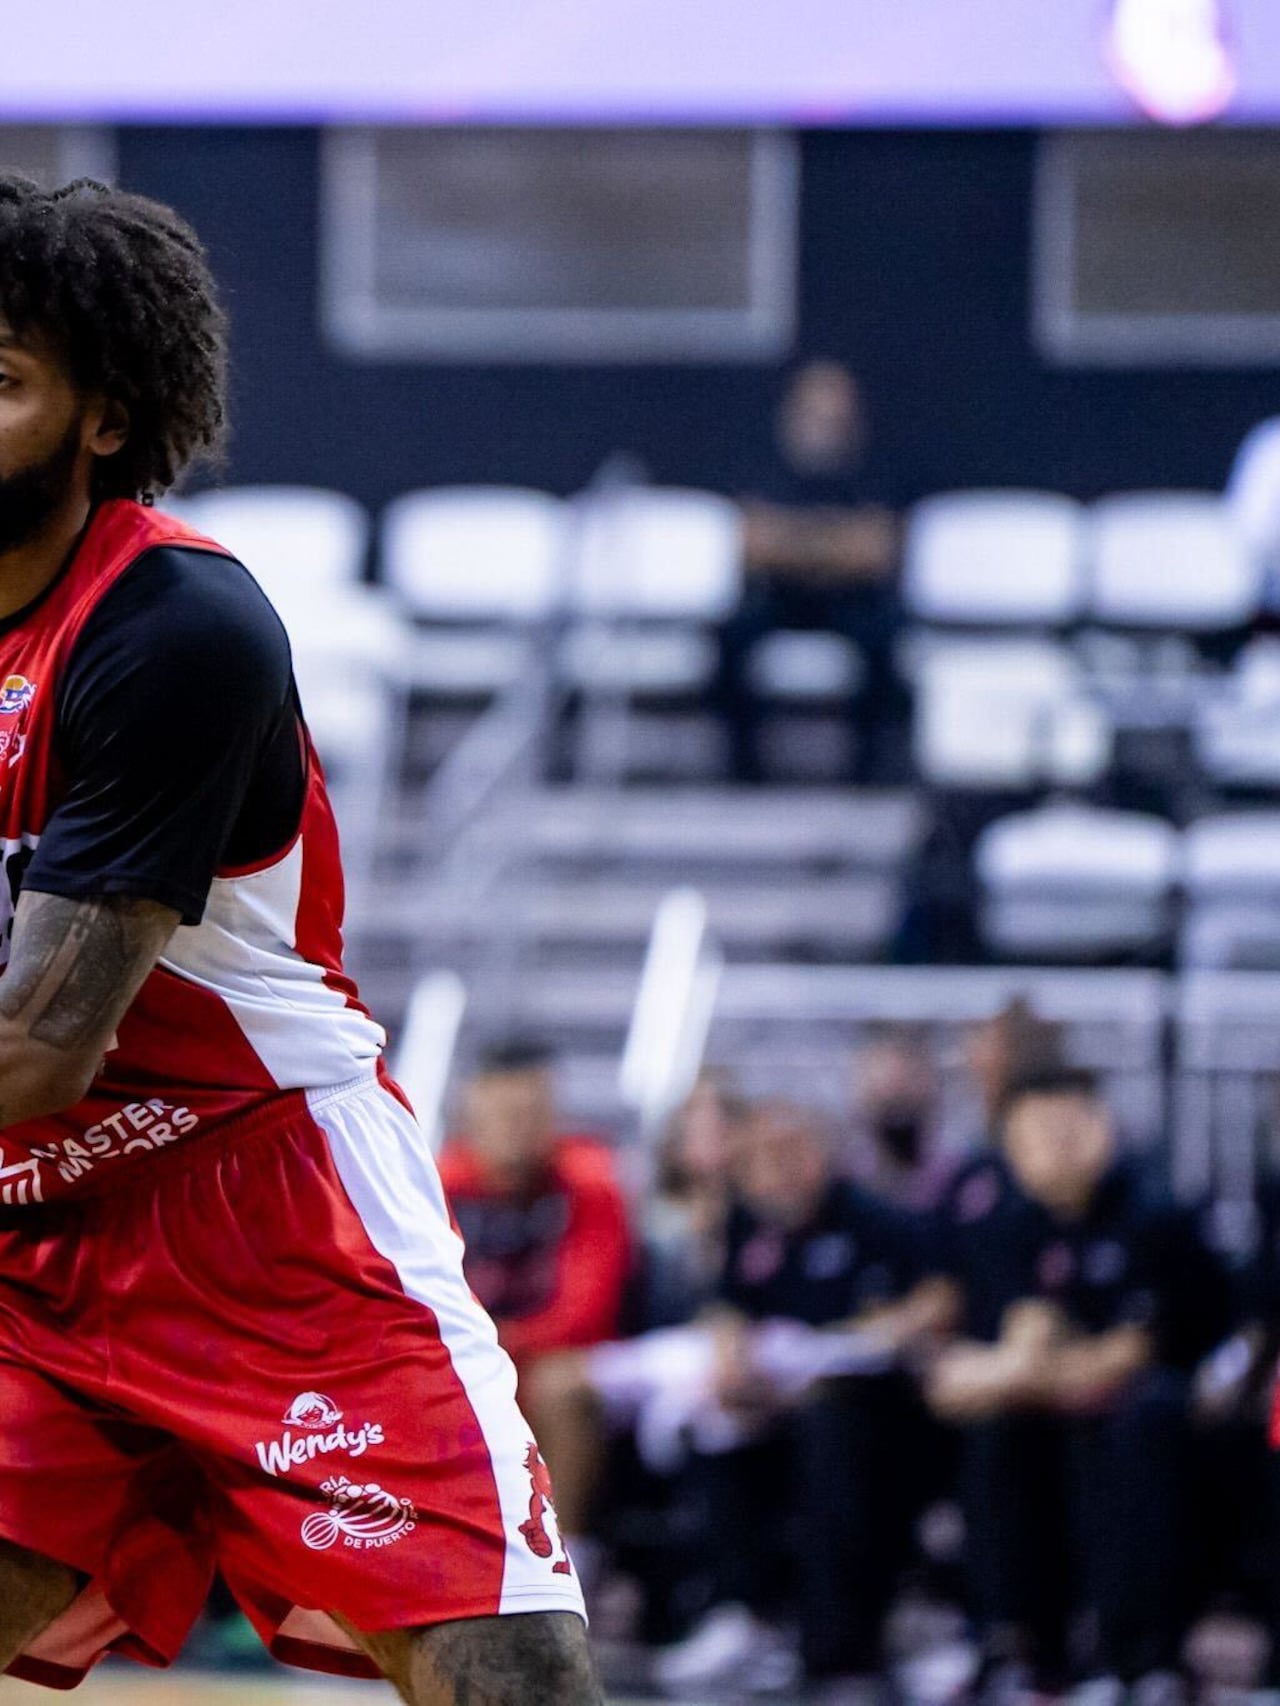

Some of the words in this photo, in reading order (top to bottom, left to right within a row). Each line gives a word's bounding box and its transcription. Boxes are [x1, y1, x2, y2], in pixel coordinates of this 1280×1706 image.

[58, 1107, 199, 1183] MORS
[255, 1422, 385, 1477] Wendy's
[344, 1536, 361, 1549] DE
[365, 1521, 416, 1549] PUERTO
